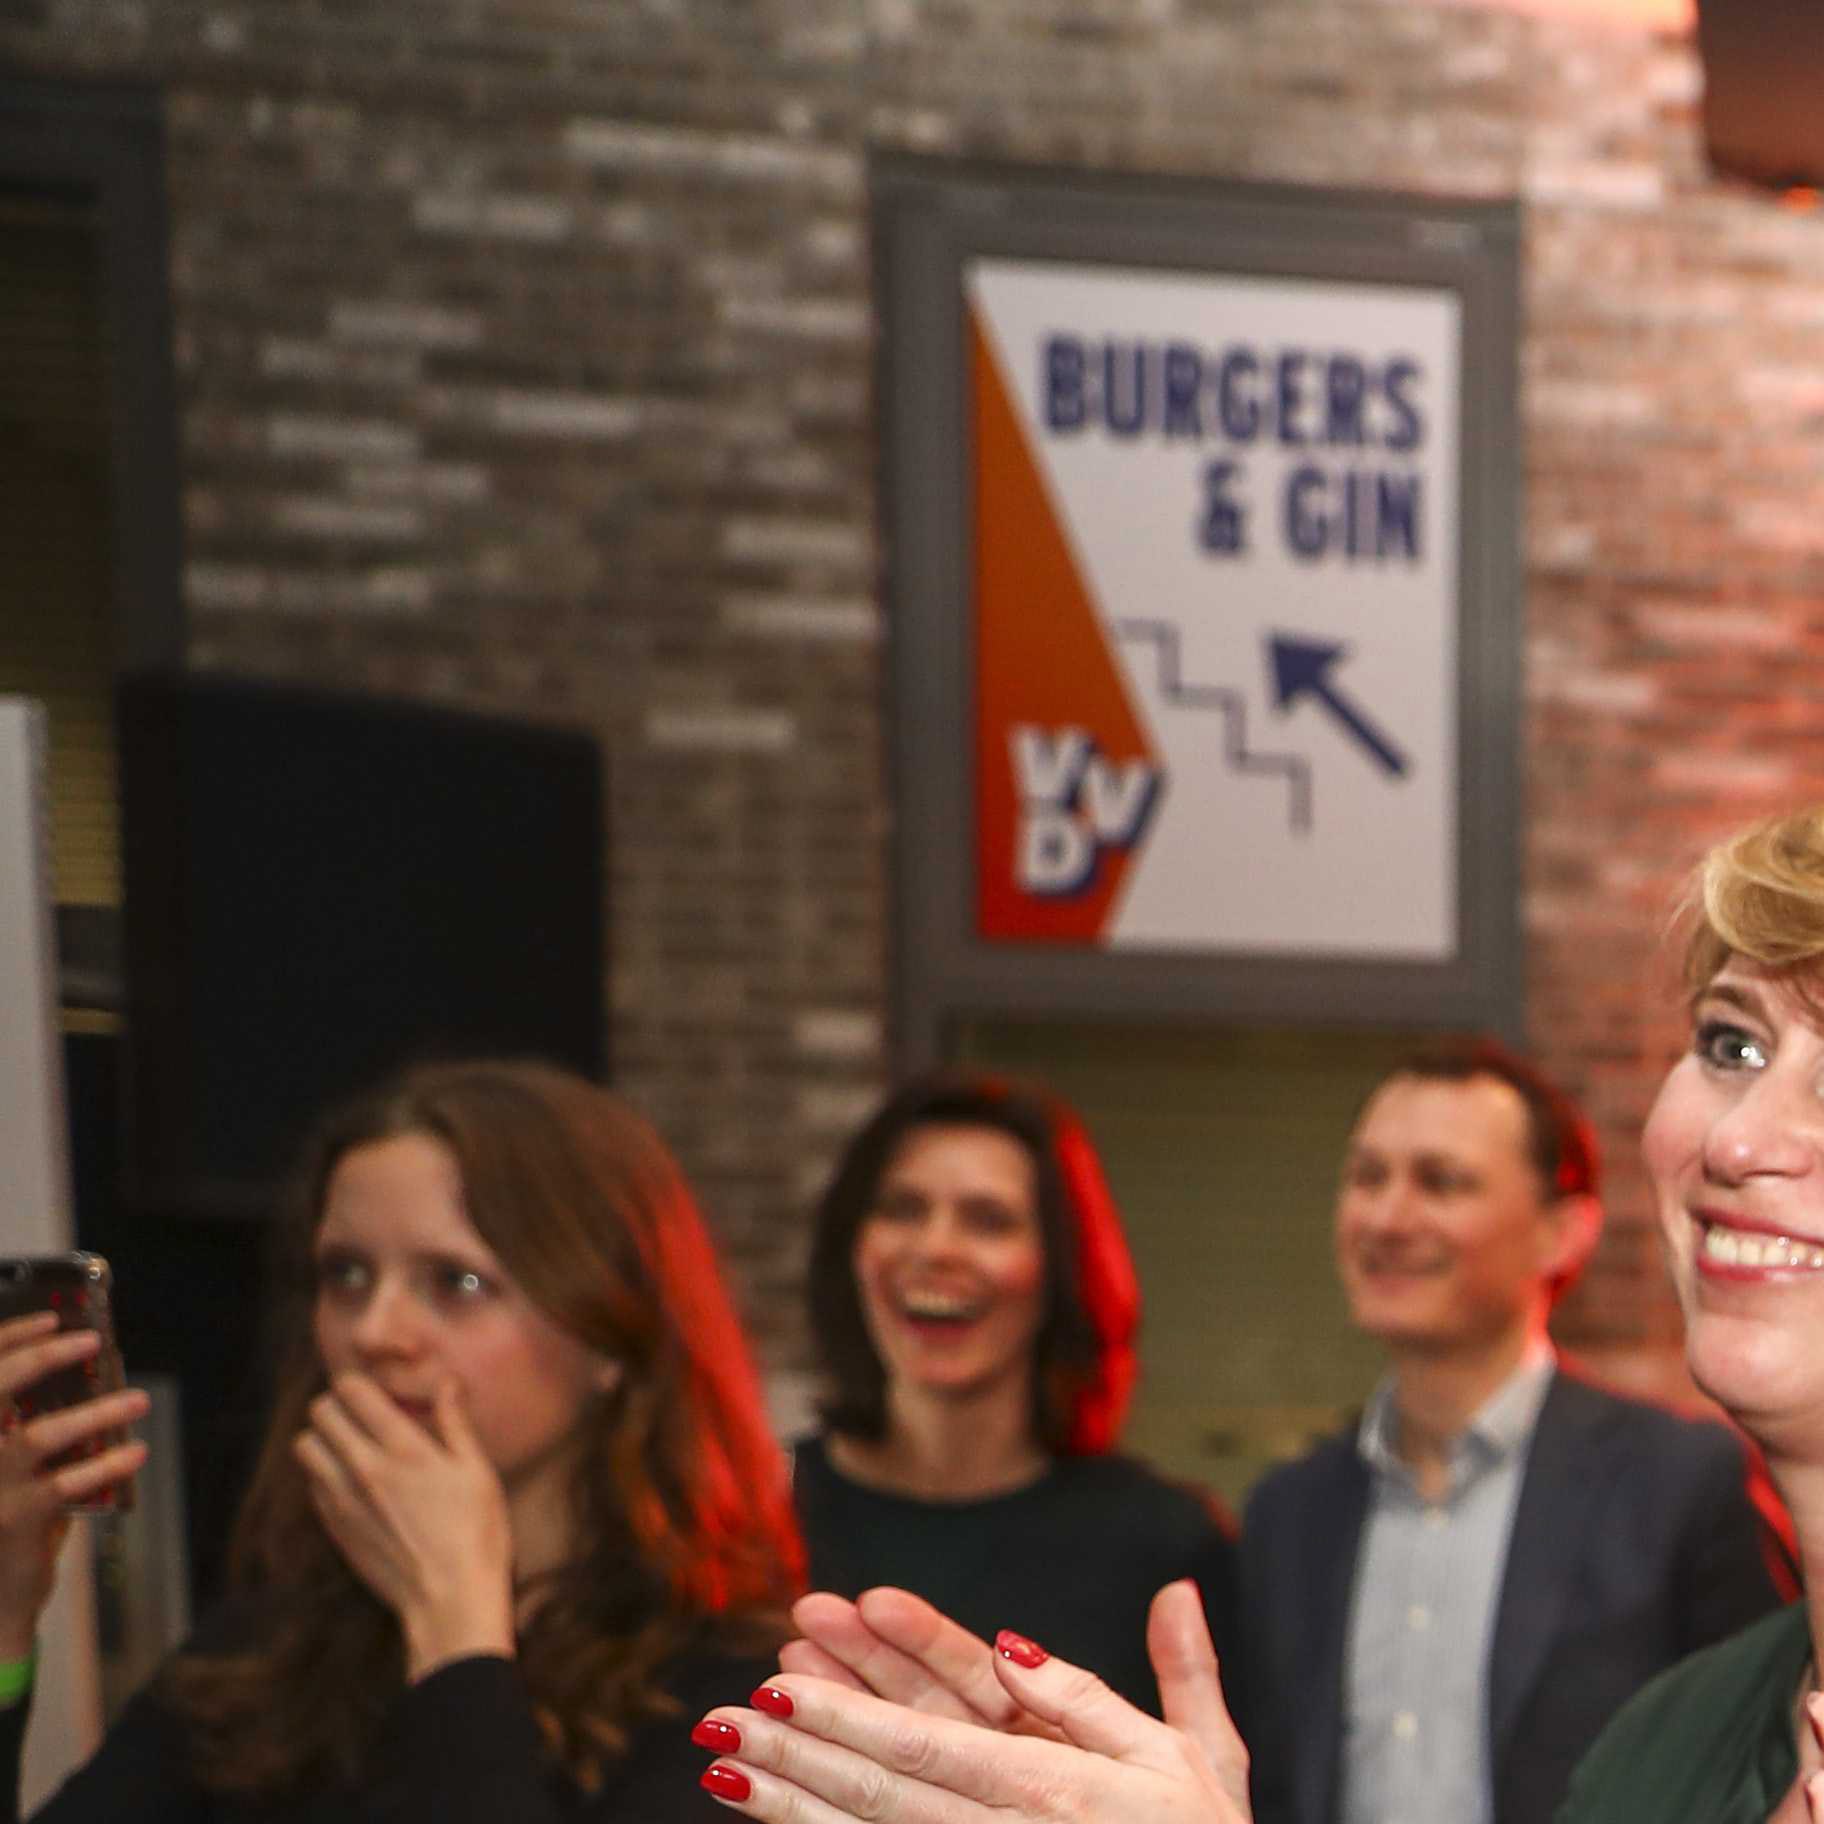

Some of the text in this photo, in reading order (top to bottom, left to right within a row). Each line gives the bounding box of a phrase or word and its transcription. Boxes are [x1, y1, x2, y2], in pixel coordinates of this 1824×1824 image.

[1046, 336, 1422, 452] BURGERS
[1202, 460, 1421, 565] & GIN
